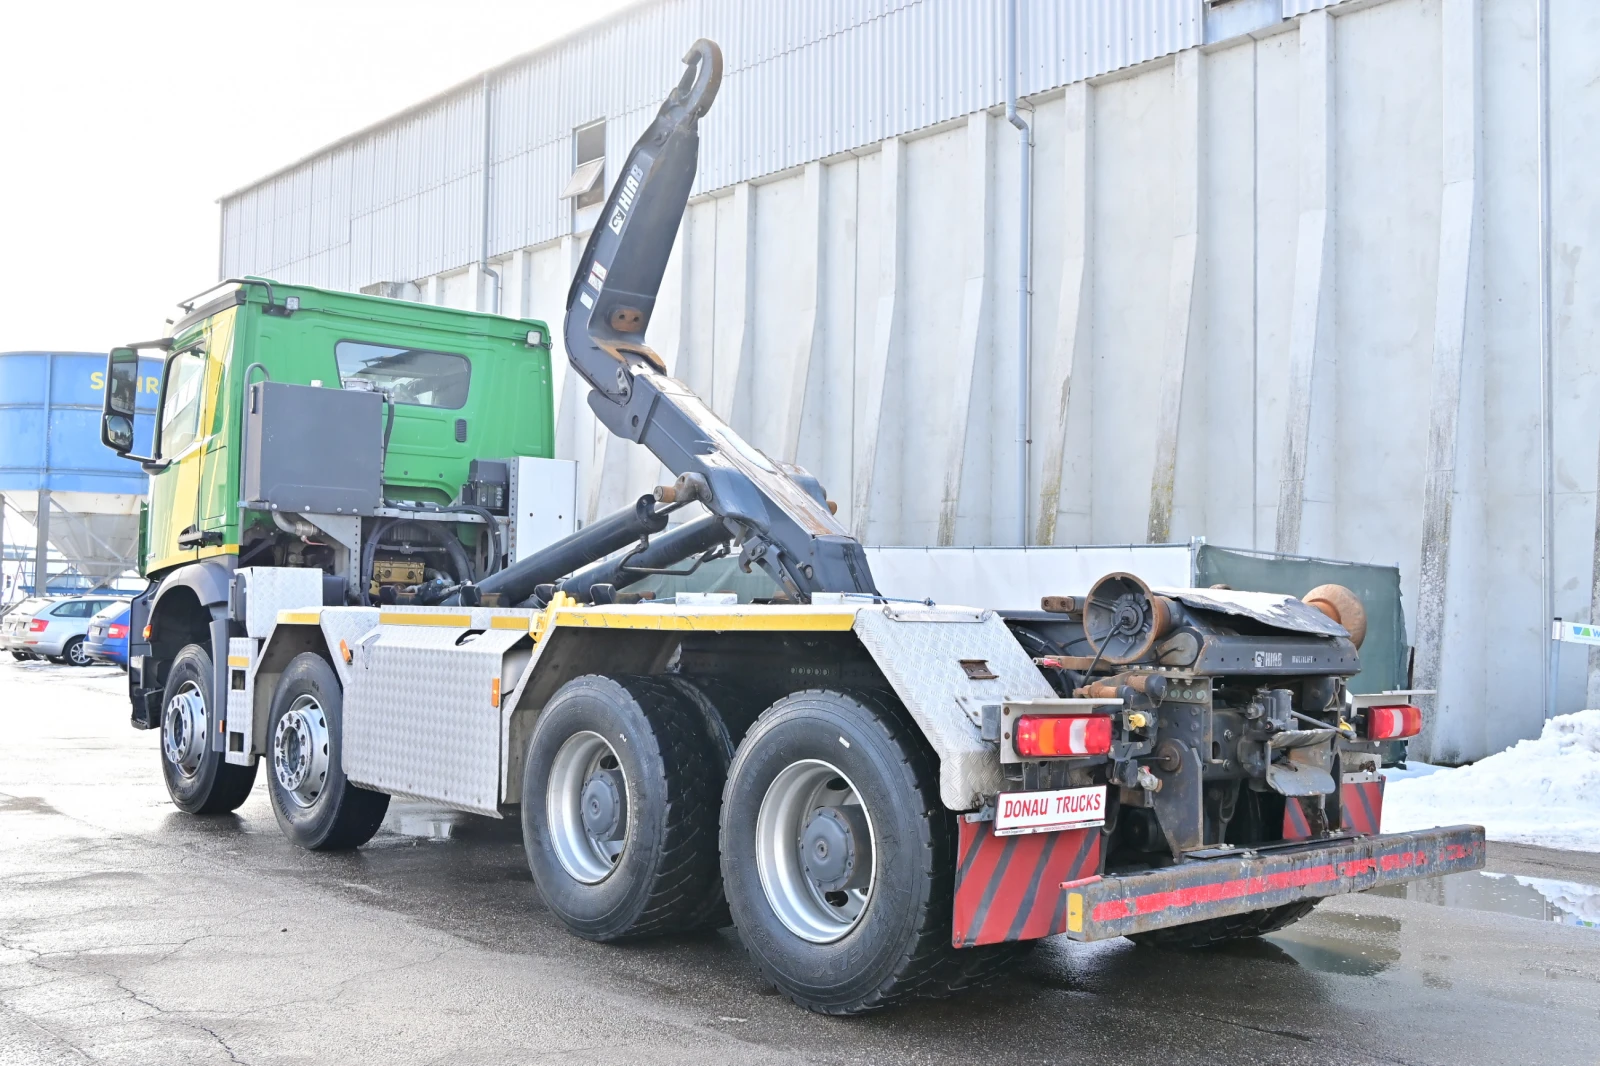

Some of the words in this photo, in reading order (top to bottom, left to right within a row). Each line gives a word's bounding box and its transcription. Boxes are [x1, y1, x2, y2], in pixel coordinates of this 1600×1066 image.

[619, 163, 644, 211] HIAB
[1265, 652, 1282, 667] HIAB
[1003, 798, 1049, 818] DONAU
[1056, 793, 1102, 814] TRUCKS
